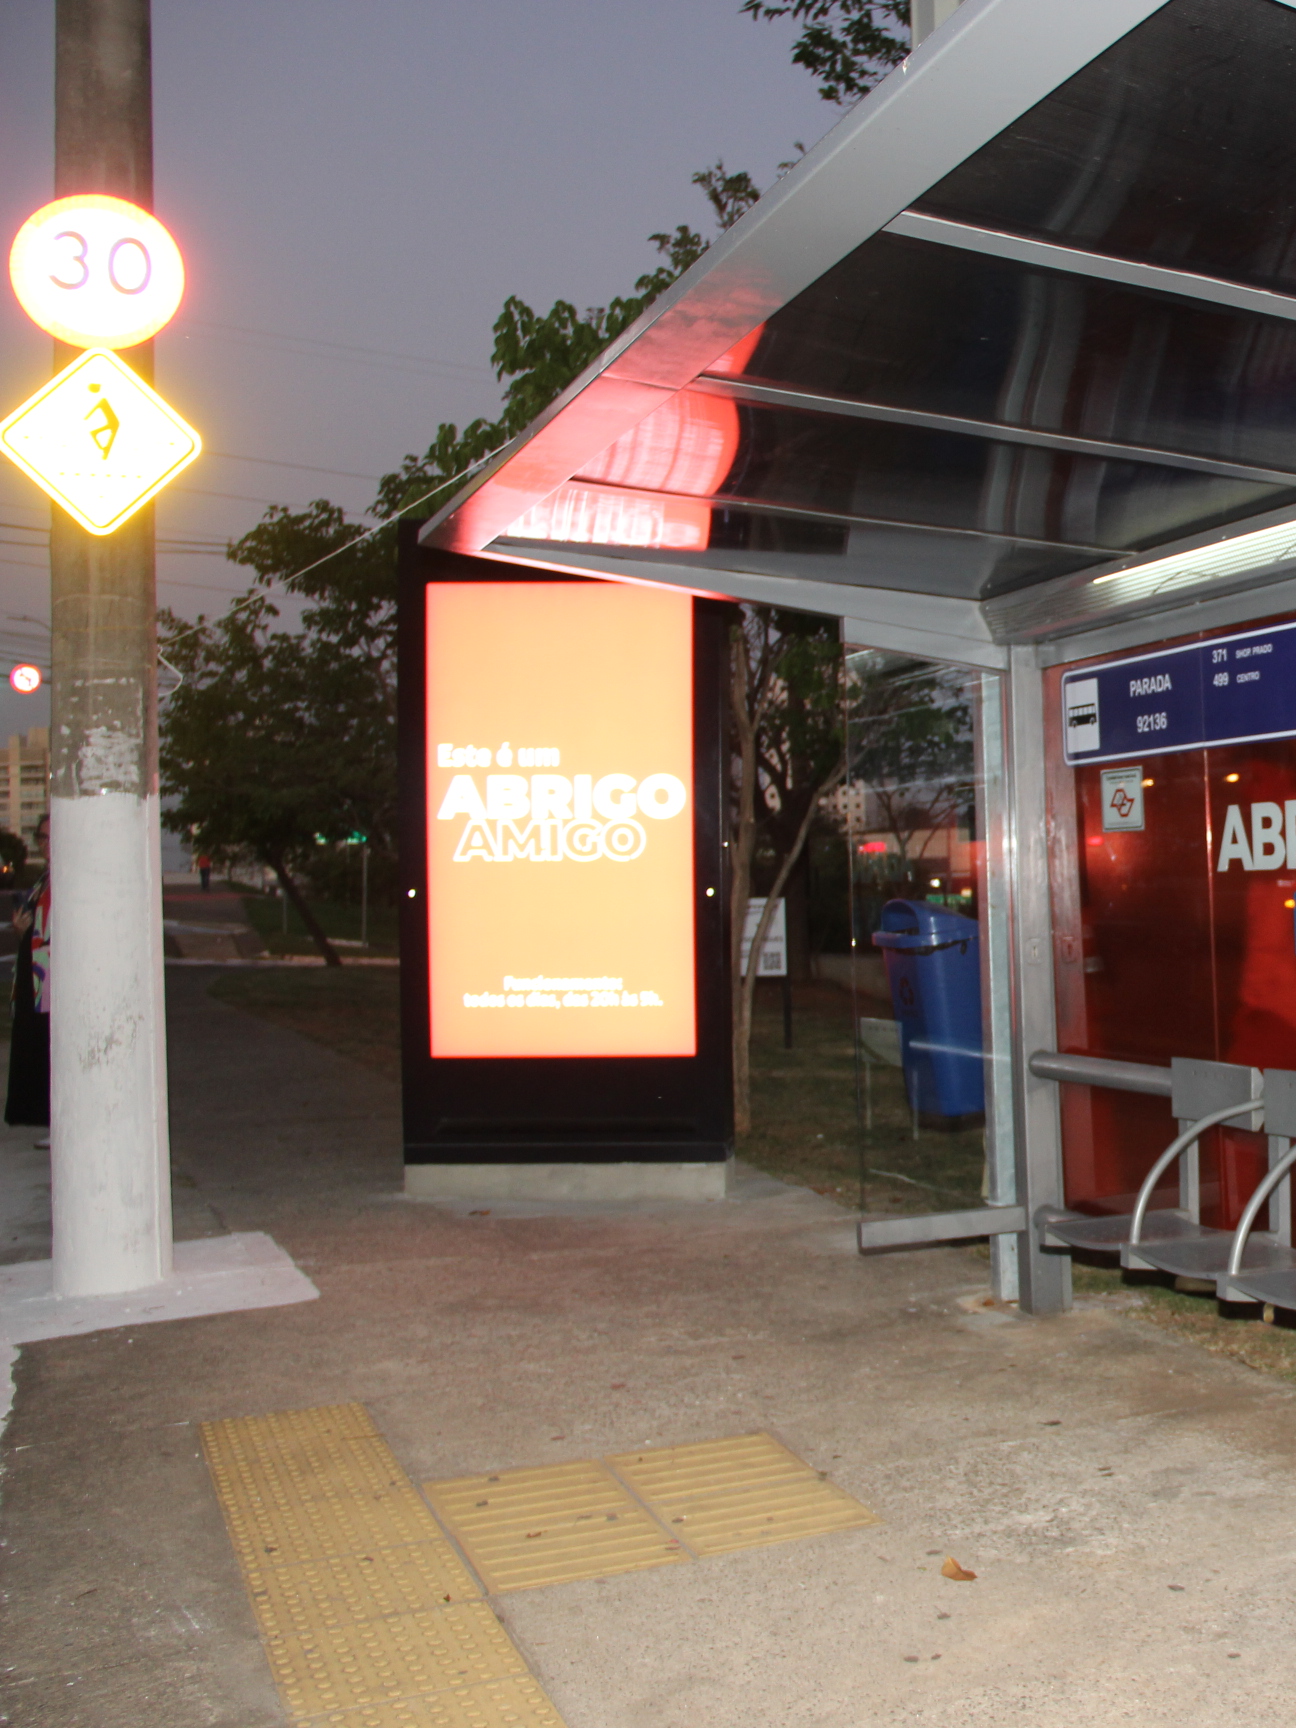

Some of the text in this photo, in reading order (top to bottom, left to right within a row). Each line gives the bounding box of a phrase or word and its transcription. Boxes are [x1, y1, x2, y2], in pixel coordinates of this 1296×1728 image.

[49, 230, 152, 295] 30
[1212, 648, 1227, 663] 371
[1252, 643, 1273, 655] PRADO
[1130, 674, 1172, 697] PARADA
[1213, 671, 1260, 687] 499 CENTRO
[1137, 712, 1168, 733] 92136
[437, 741, 560, 768] Este é um
[437, 773, 687, 820] ABRIGO
[453, 818, 647, 862] AMIGO
